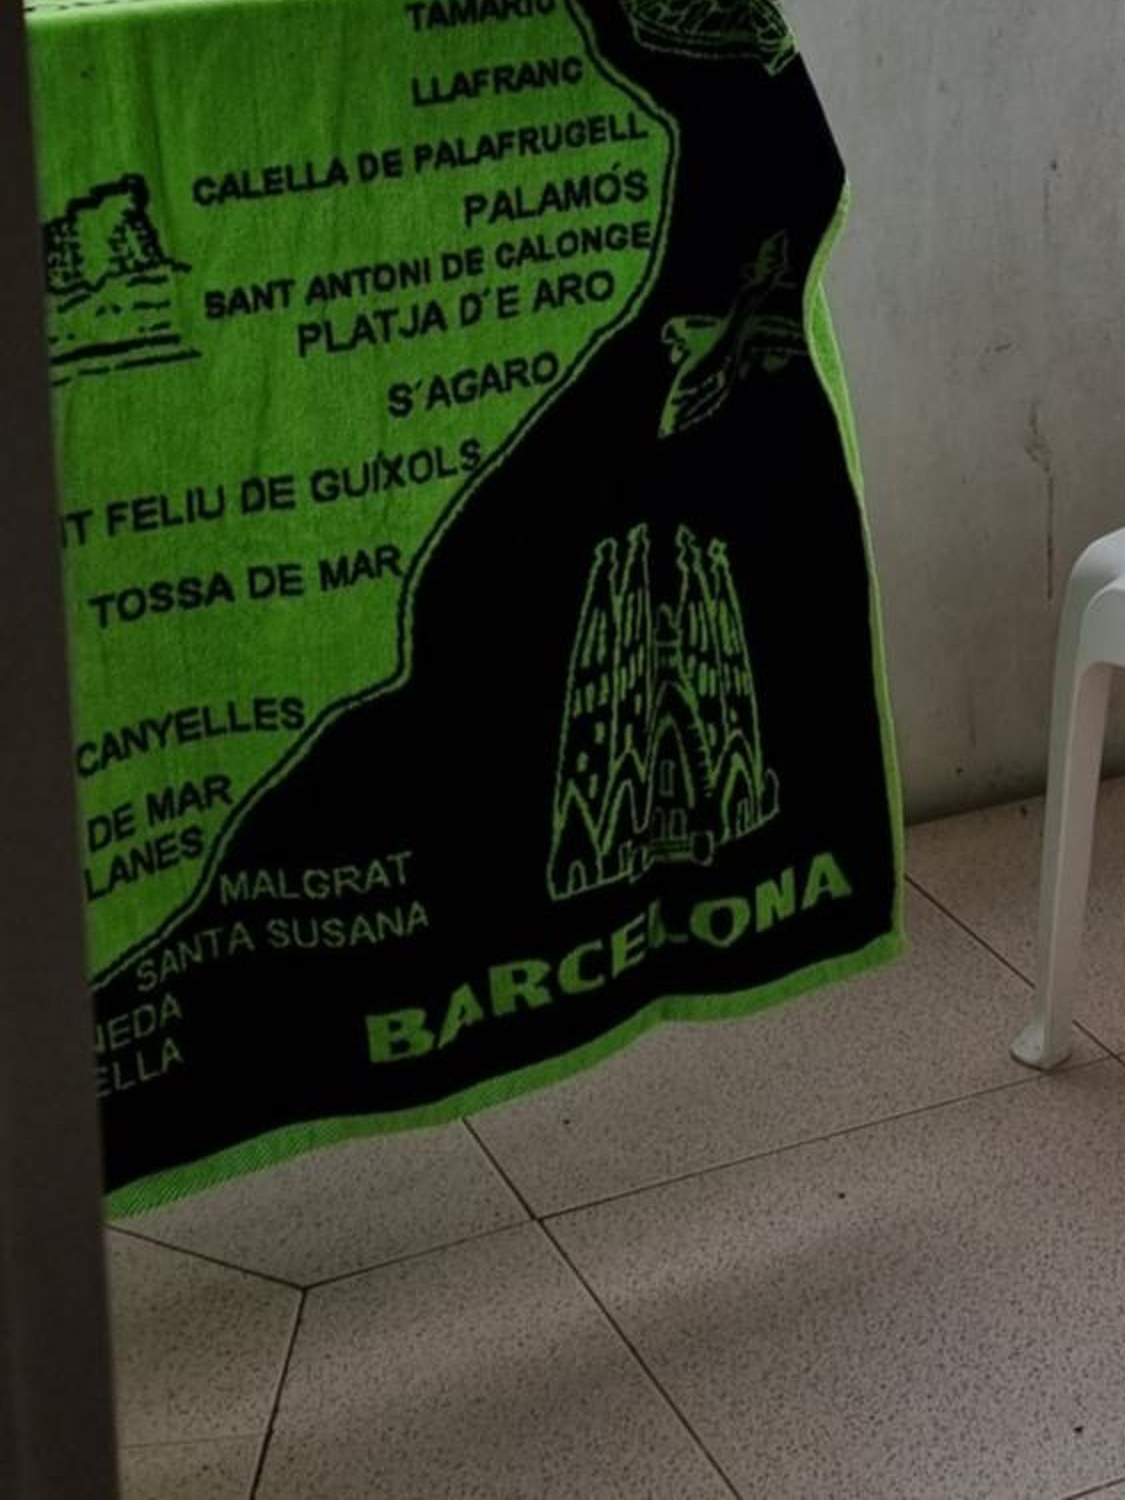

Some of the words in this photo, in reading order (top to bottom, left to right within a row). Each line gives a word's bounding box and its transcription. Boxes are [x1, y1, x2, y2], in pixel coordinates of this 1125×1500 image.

[411, 56, 583, 107] LLAFRANC
[192, 156, 348, 206] CALELLA
[357, 148, 402, 182] DE
[413, 111, 649, 173] PALAFRUGELL
[463, 162, 650, 228] PALAMÓS
[204, 277, 295, 320] SANT
[304, 256, 432, 305] ANTONI
[440, 245, 485, 281] DE
[494, 221, 653, 269] CALONGE
[296, 299, 448, 358] PLATJA
[532, 270, 616, 312] ARO
[105, 485, 225, 537] FELIU
[240, 474, 296, 514] DE
[88, 572, 236, 628] TOSSA
[246, 563, 305, 600] DE
[318, 543, 403, 592] MAR
[76, 696, 306, 776] CANYELLES
[86, 802, 136, 853] DE
[145, 773, 233, 827] MAR
[219, 850, 413, 907] MALGRAT
[136, 920, 256, 991] SANTA
[266, 901, 430, 948] SUSANA
[365, 852, 853, 1063] BARCELONA
